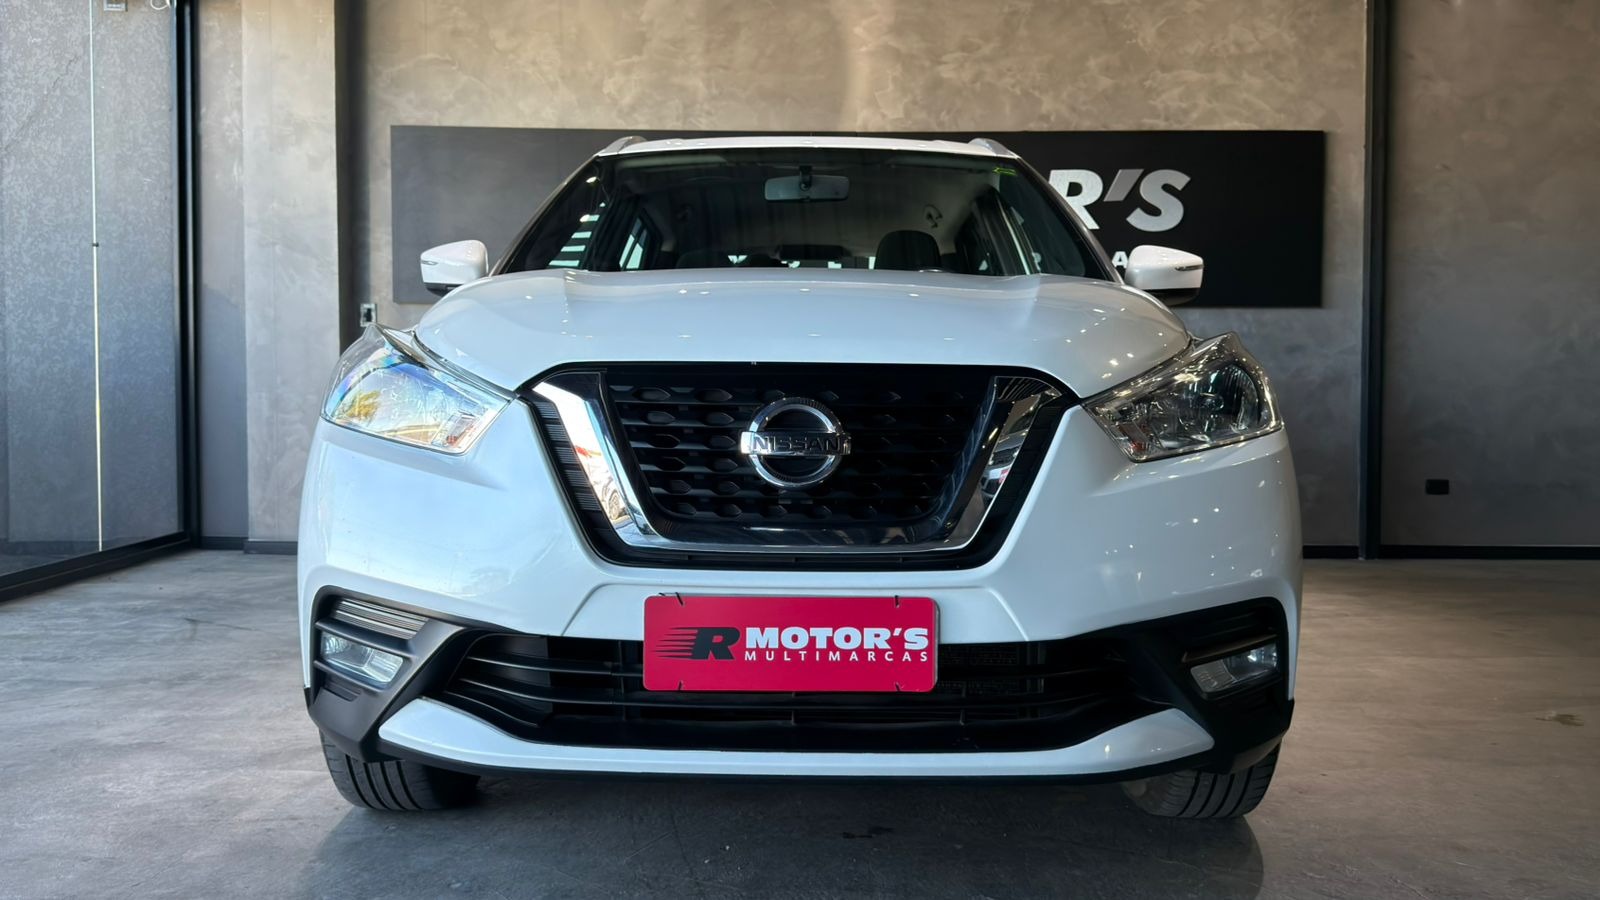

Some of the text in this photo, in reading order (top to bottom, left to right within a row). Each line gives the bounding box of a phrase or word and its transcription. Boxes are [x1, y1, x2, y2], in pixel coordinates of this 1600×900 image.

[753, 434, 840, 451] NISSAN
[690, 626, 929, 660] R MOTOR'S
[744, 650, 929, 662] MULTIMARCAS
